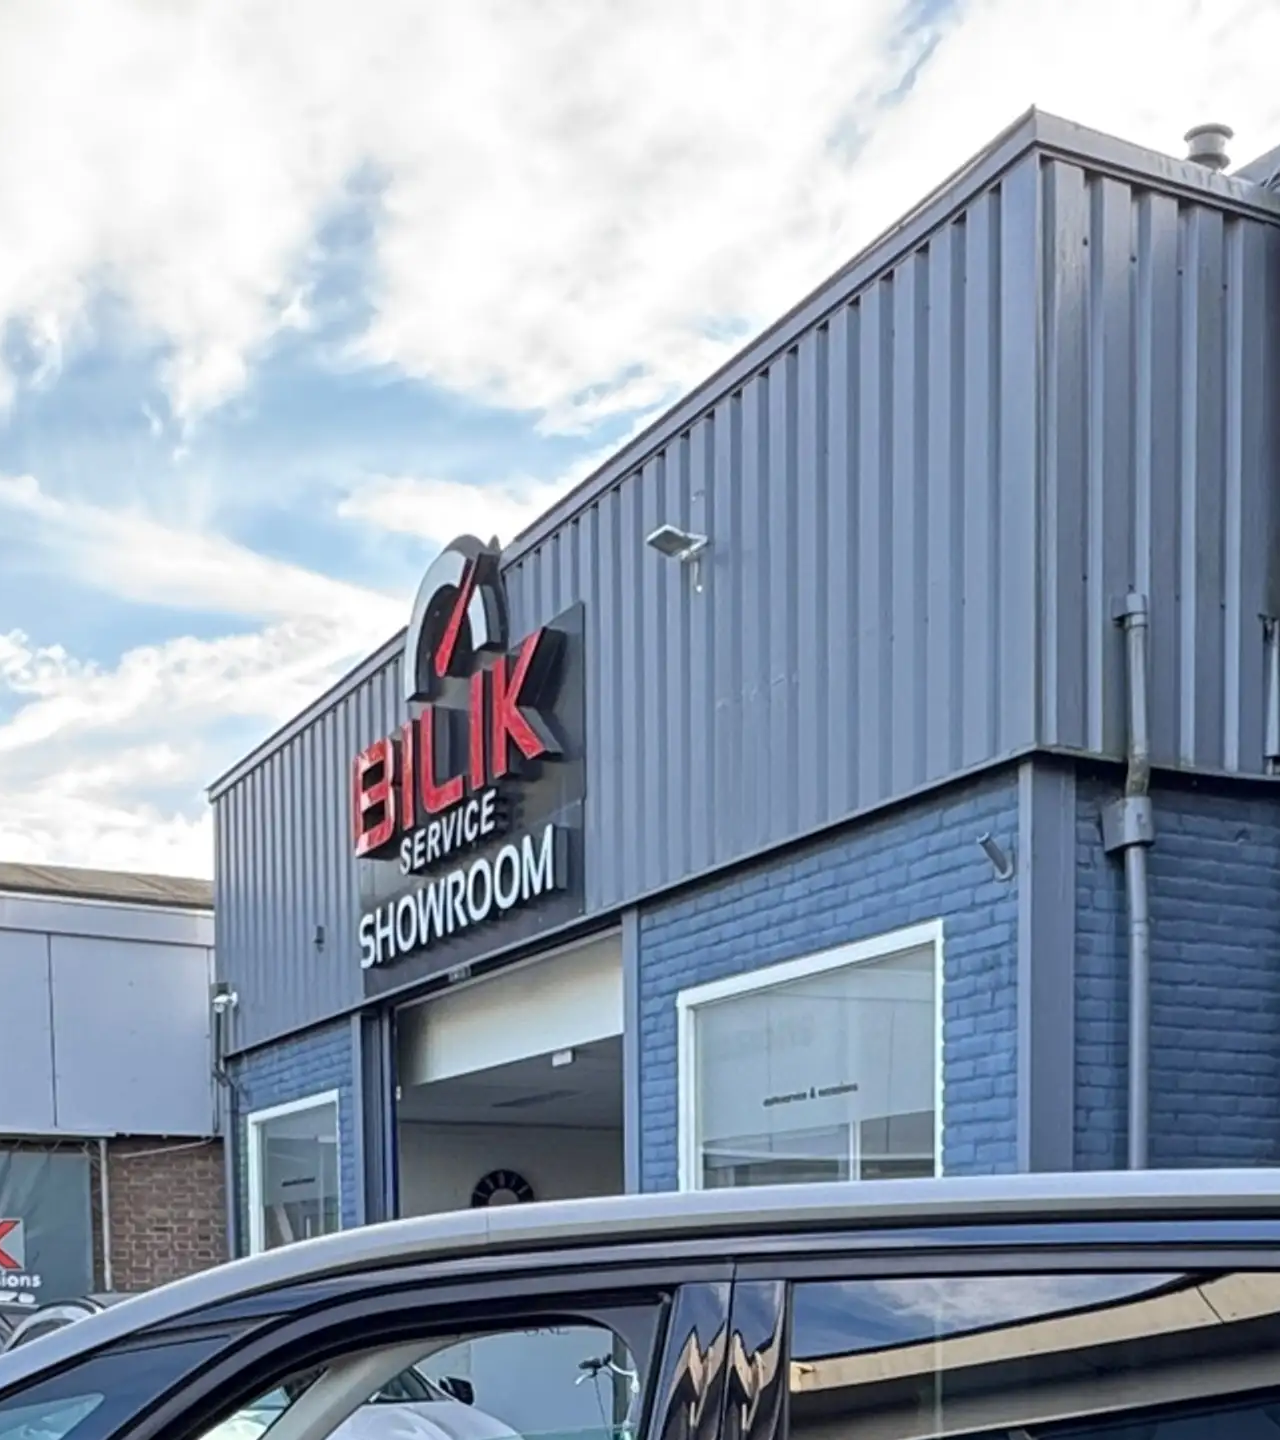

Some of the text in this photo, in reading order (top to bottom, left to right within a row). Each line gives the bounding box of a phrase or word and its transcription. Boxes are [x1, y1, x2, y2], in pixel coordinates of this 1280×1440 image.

[352, 627, 548, 858] BILIK
[359, 824, 554, 969] SHOWROOM
[400, 789, 496, 876] SERVICE
